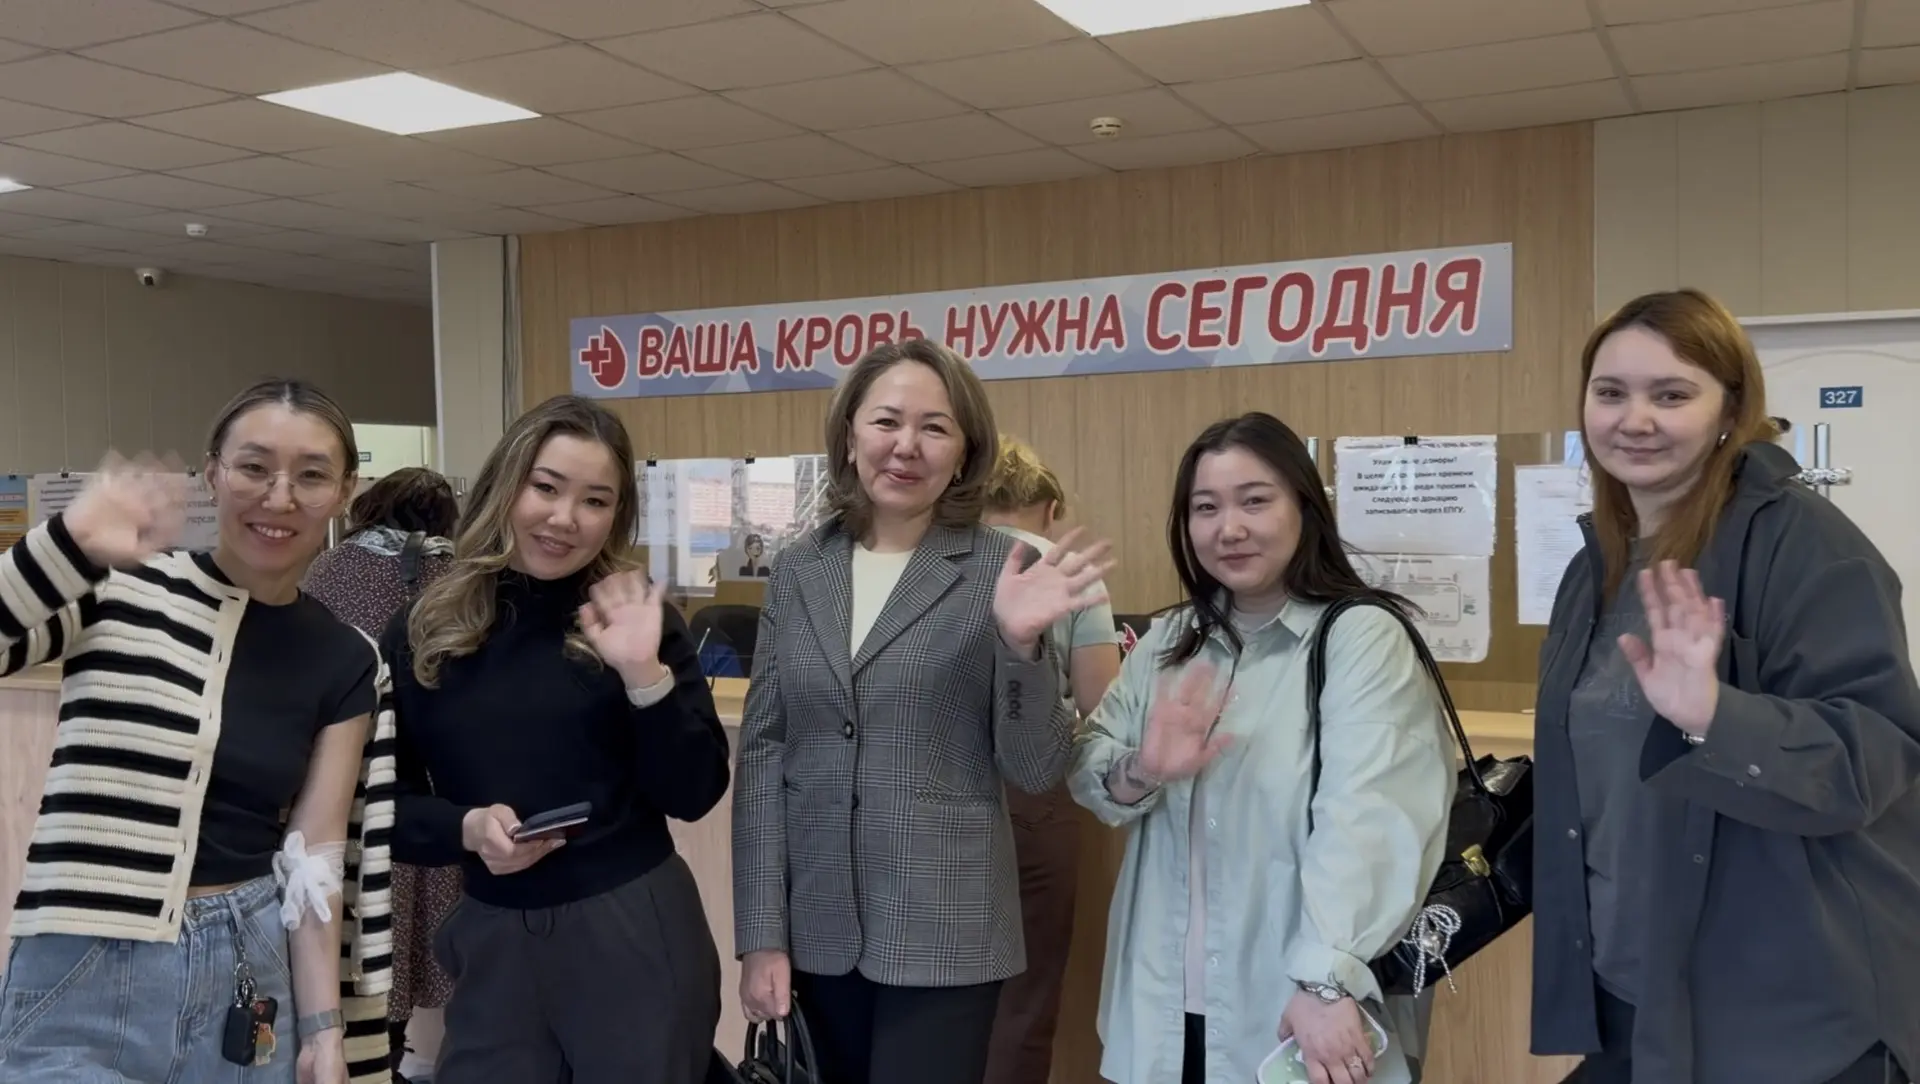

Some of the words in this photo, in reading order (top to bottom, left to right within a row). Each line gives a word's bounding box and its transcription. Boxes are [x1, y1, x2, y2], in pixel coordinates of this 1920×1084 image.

[637, 320, 758, 376] ВАША
[775, 309, 925, 370] КРОВЬ
[944, 294, 1125, 359] НУЖНА
[1146, 257, 1482, 354] СЕГОДНЯ
[1825, 390, 1857, 405] 327
